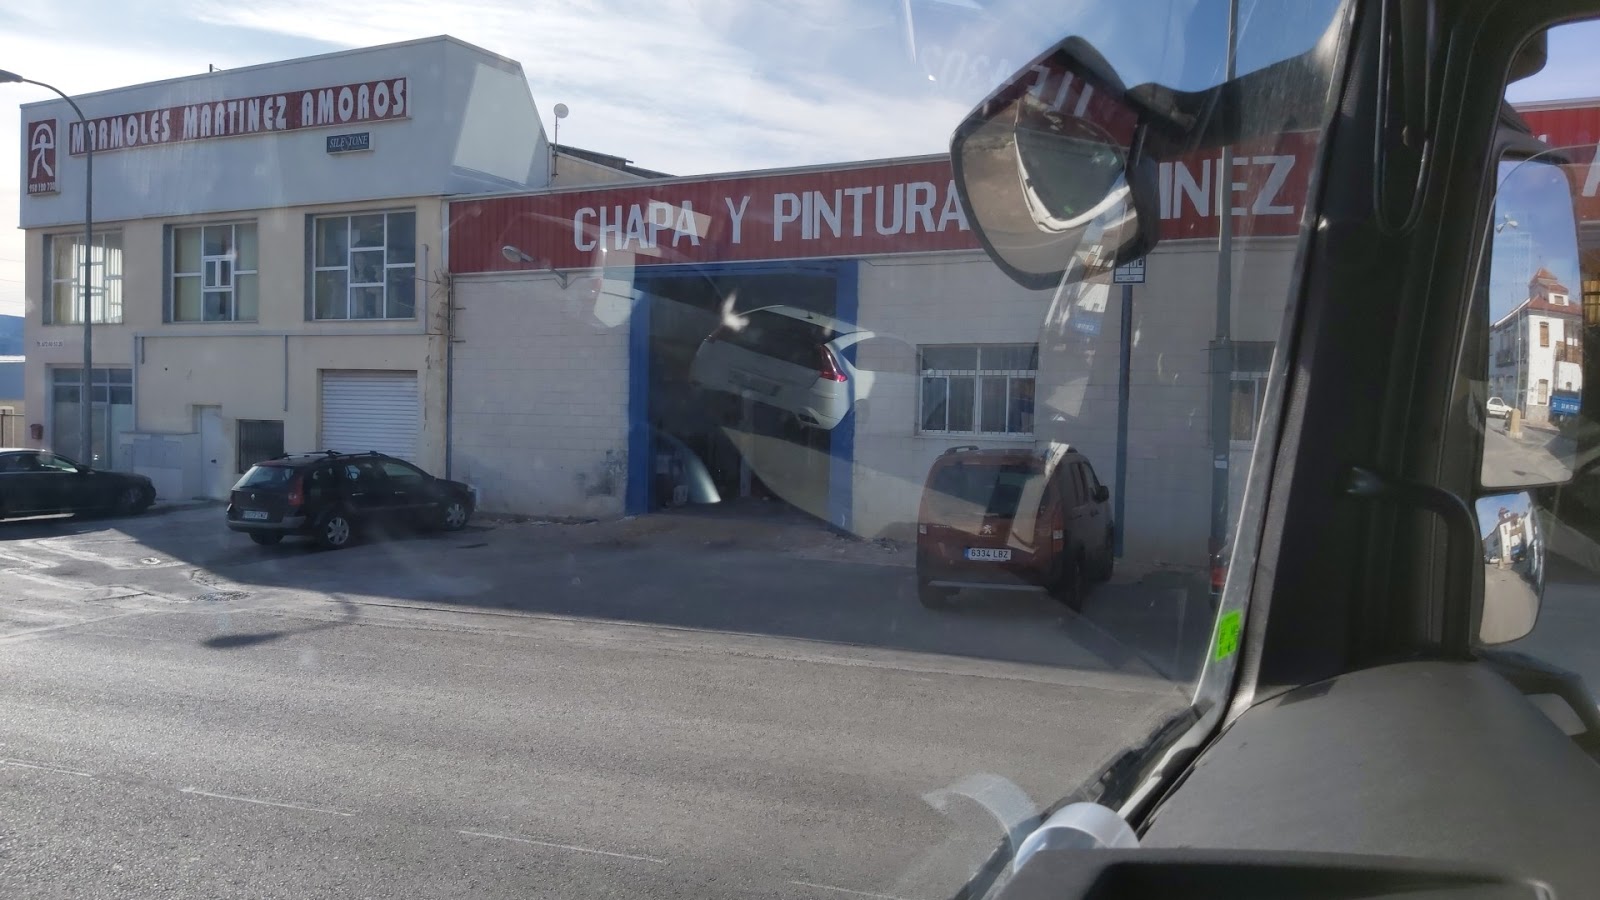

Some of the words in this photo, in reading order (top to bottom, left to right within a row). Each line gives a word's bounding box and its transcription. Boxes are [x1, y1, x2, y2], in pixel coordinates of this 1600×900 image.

[72, 110, 170, 153] MARMOLES
[183, 95, 287, 140] MARTINEZ
[301, 80, 404, 126] AMOROS
[574, 200, 701, 252] CHAPA
[724, 195, 751, 244] Y
[773, 179, 971, 242] PINTURA
[1158, 154, 1296, 220] INEZ
